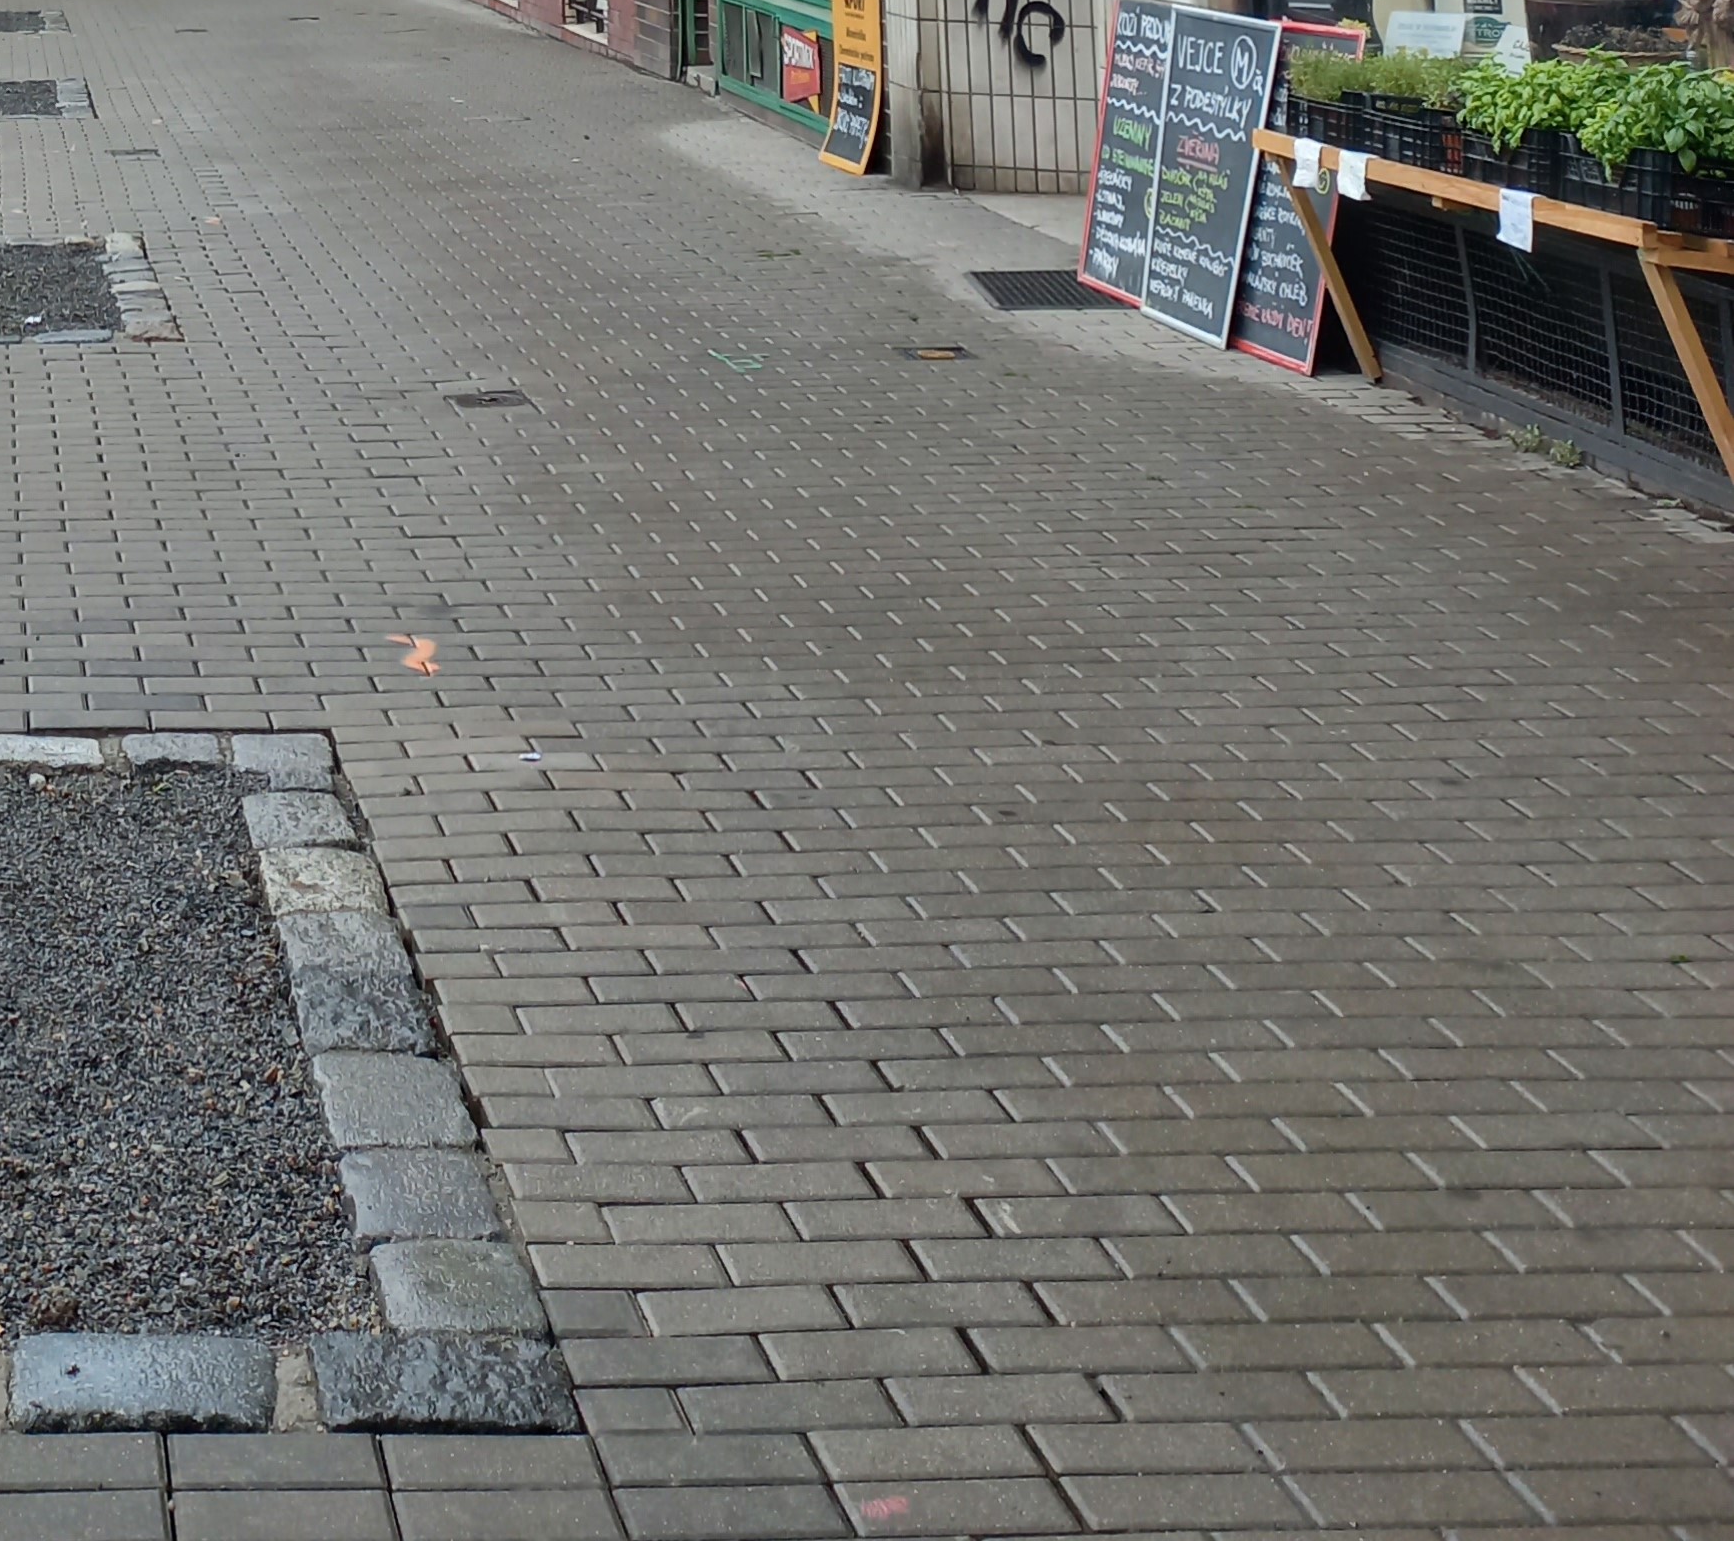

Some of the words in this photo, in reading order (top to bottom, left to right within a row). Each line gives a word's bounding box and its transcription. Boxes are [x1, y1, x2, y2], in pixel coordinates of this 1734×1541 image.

[1177, 34, 1225, 75] VEJCE
[1170, 83, 1182, 107] Z
[1183, 85, 1253, 129] PODESTÝLKY
